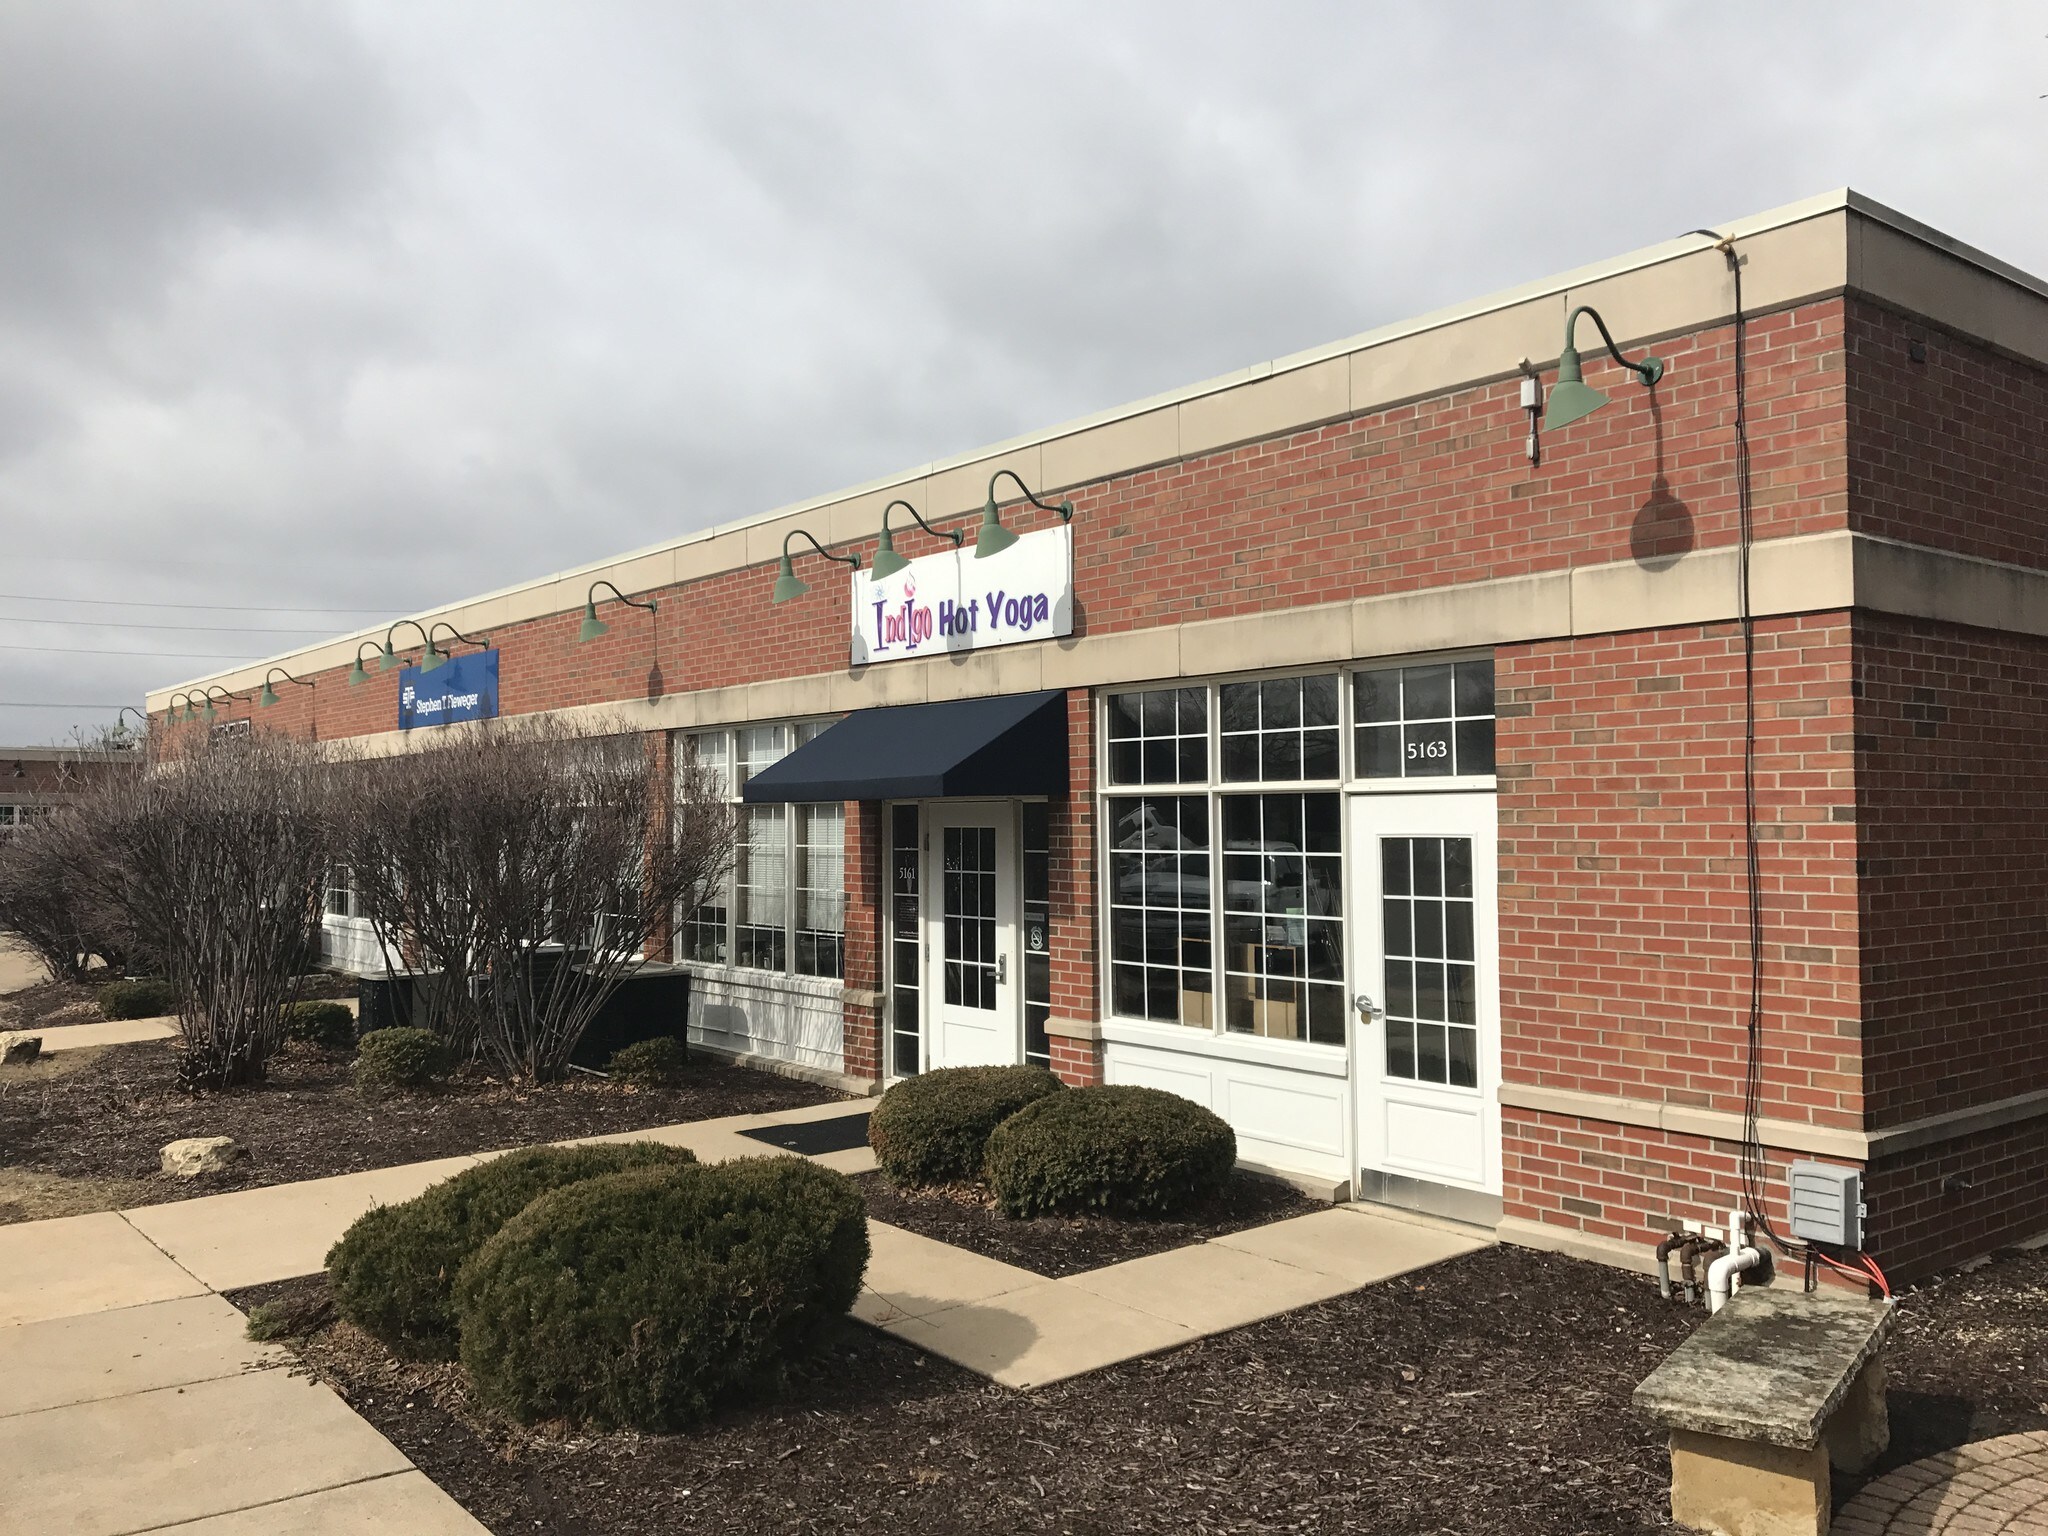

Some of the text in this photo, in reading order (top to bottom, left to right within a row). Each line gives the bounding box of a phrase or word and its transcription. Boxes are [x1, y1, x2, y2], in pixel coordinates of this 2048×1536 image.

[939, 599, 979, 637] Hot
[985, 590, 1049, 632] Yoga
[416, 697, 442, 716] Stephen
[1407, 740, 1448, 760] 5163
[899, 867, 916, 880] 5161
